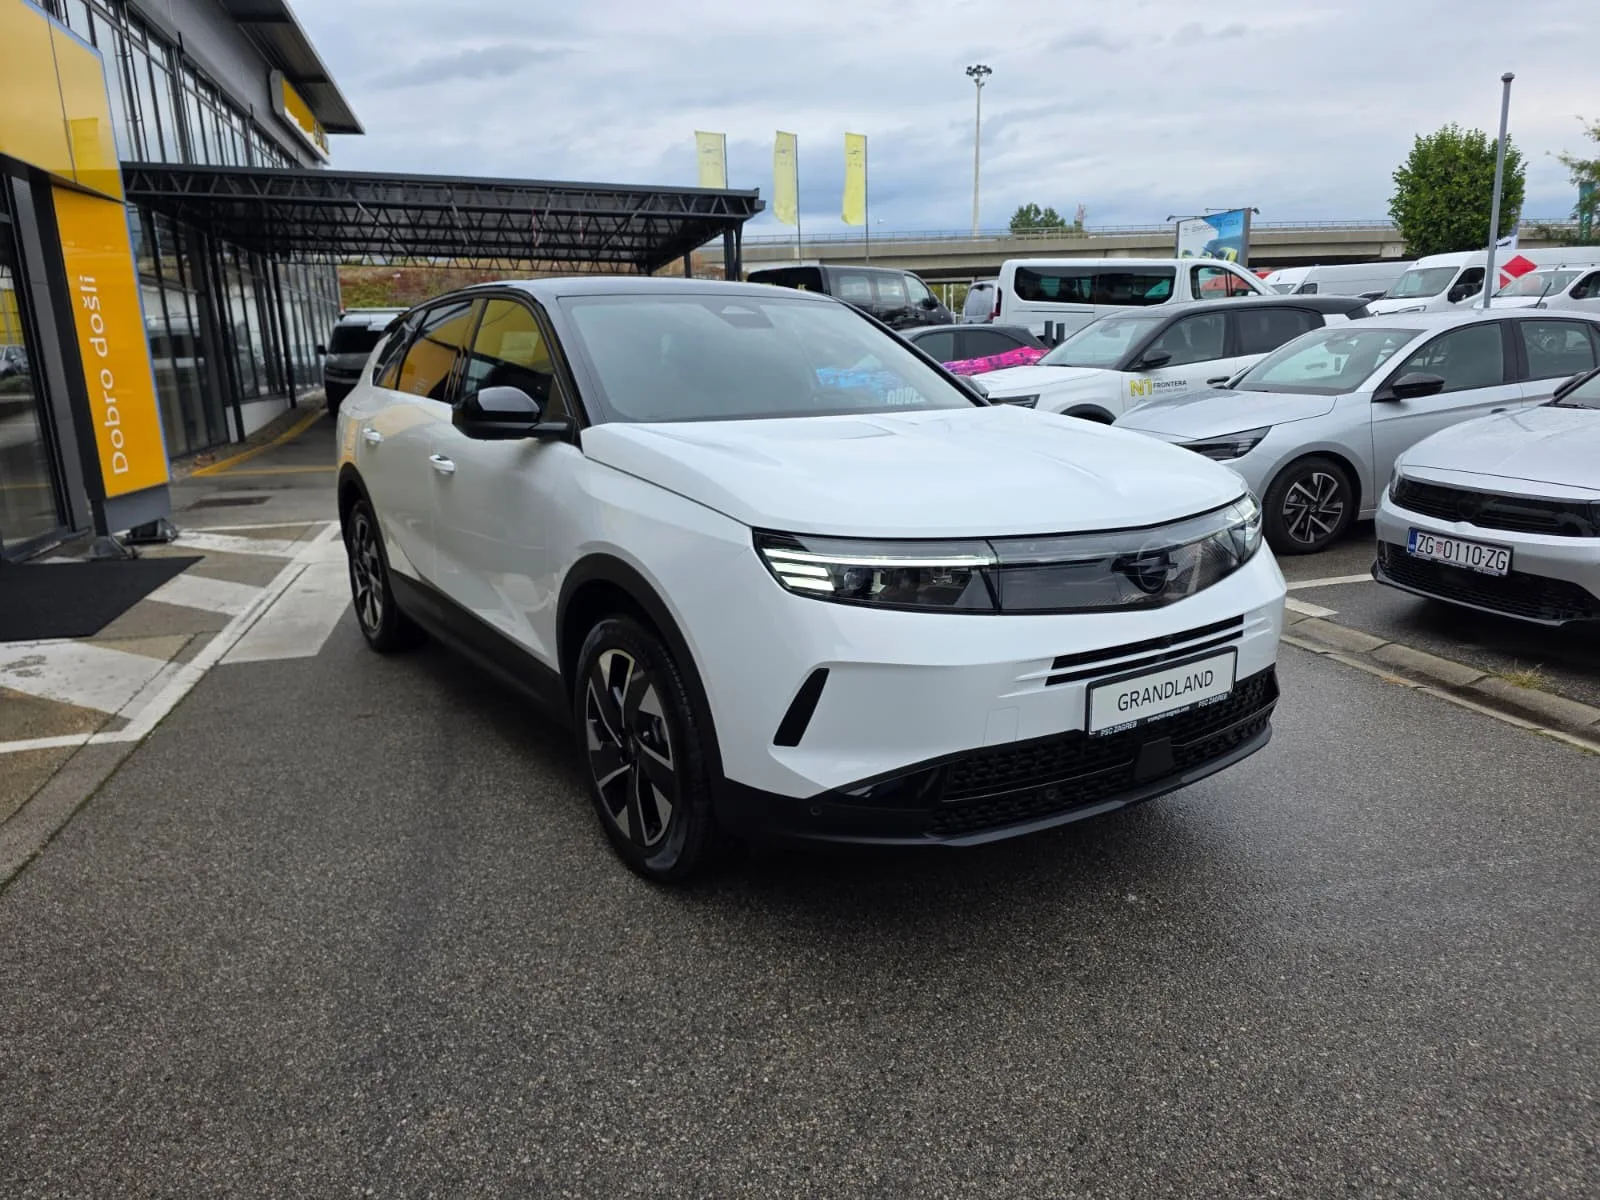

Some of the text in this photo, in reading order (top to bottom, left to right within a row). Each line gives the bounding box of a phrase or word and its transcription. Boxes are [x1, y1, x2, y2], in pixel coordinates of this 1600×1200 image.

[79, 275, 128, 474] Dobro došli
[1153, 380, 1187, 388] FRONTERA
[1417, 535, 1434, 554] ZG
[1118, 670, 1213, 711] GRANDLAND
